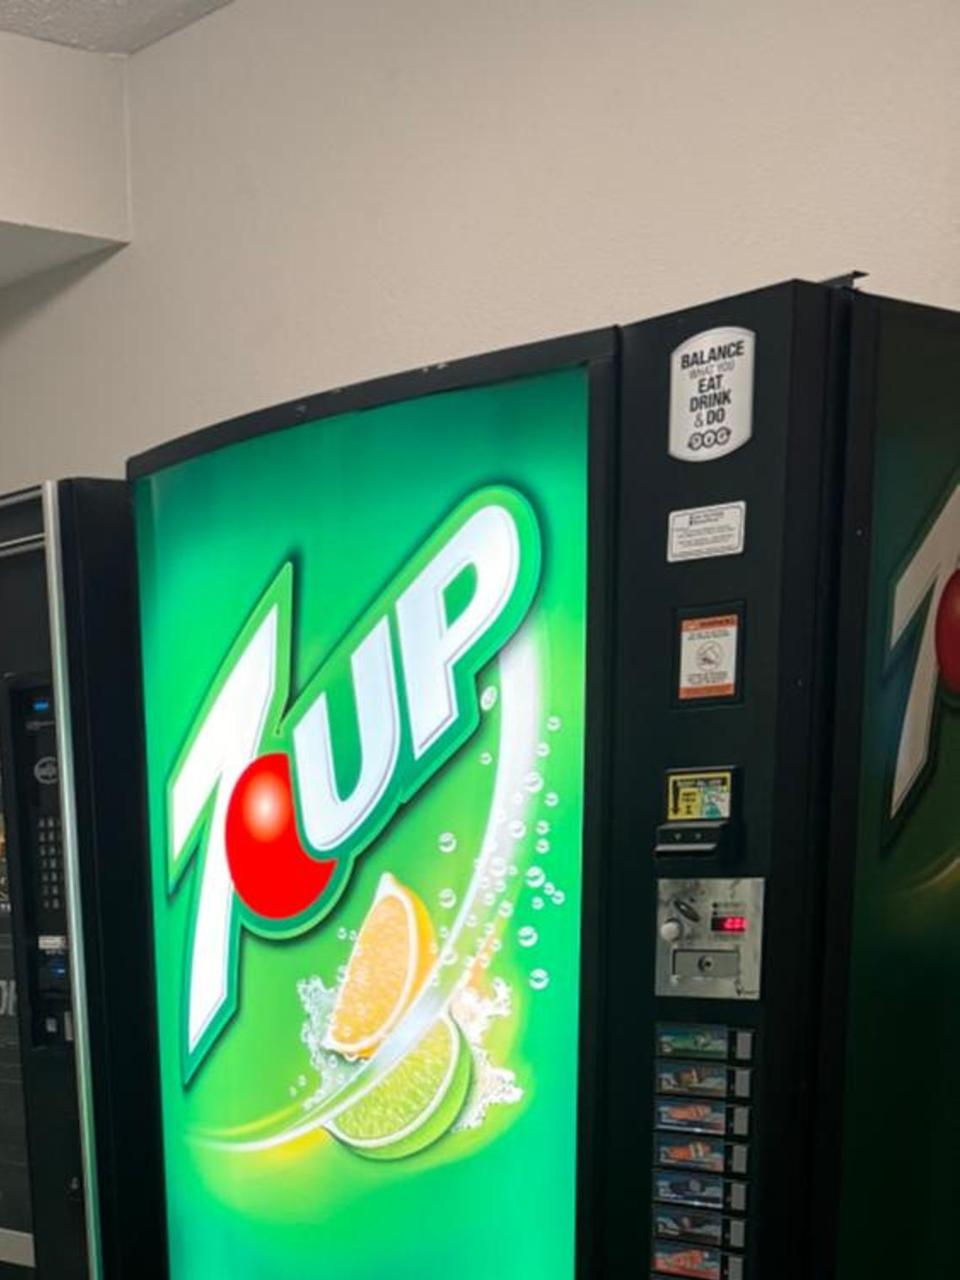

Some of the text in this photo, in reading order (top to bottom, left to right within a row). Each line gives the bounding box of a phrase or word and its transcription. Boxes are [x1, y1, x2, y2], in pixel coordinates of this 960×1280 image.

[681, 340, 745, 369] BALANCE
[698, 374, 724, 393] EAT
[689, 389, 732, 412] DRINK
[694, 408, 726, 428] & DO
